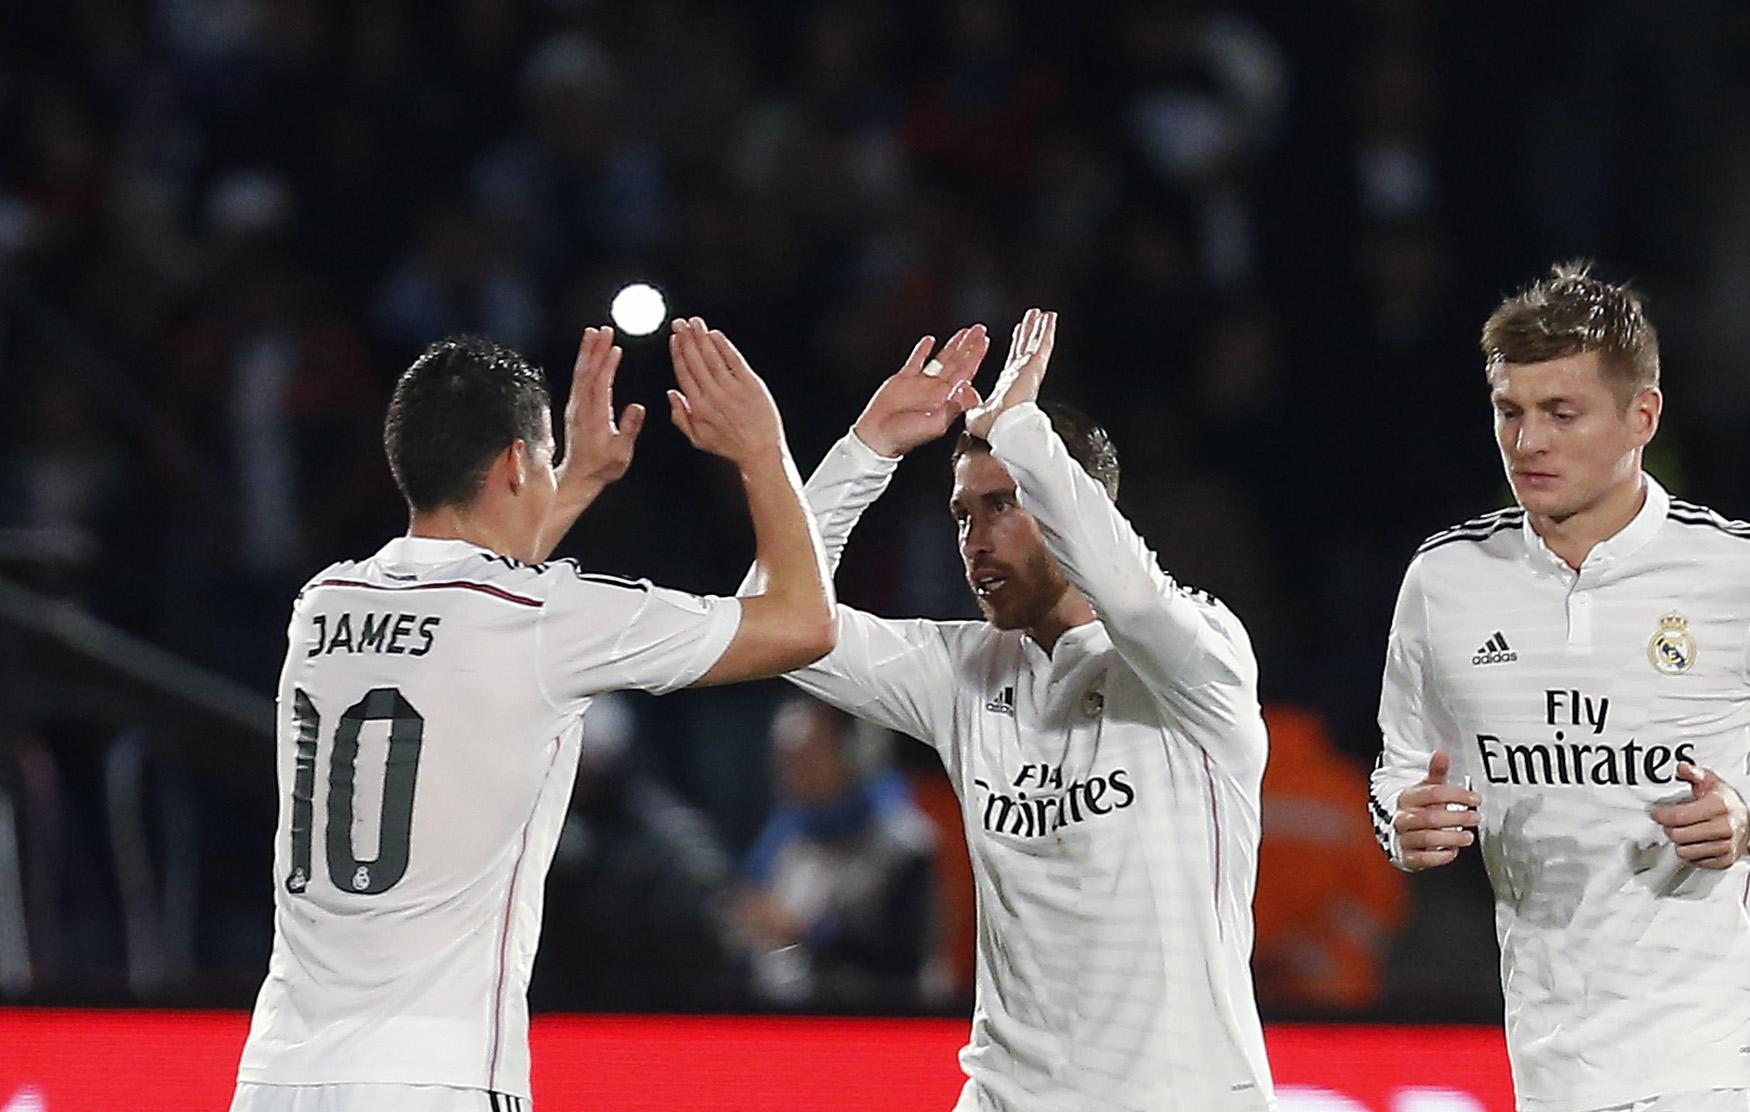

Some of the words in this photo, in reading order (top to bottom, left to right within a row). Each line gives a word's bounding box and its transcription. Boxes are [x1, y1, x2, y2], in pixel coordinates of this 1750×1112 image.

[308, 614, 440, 657] JAMES
[1472, 650, 1518, 666] adidas
[1546, 690, 1609, 734] Fly
[1477, 731, 1696, 785] Emirates
[286, 686, 424, 894] 10
